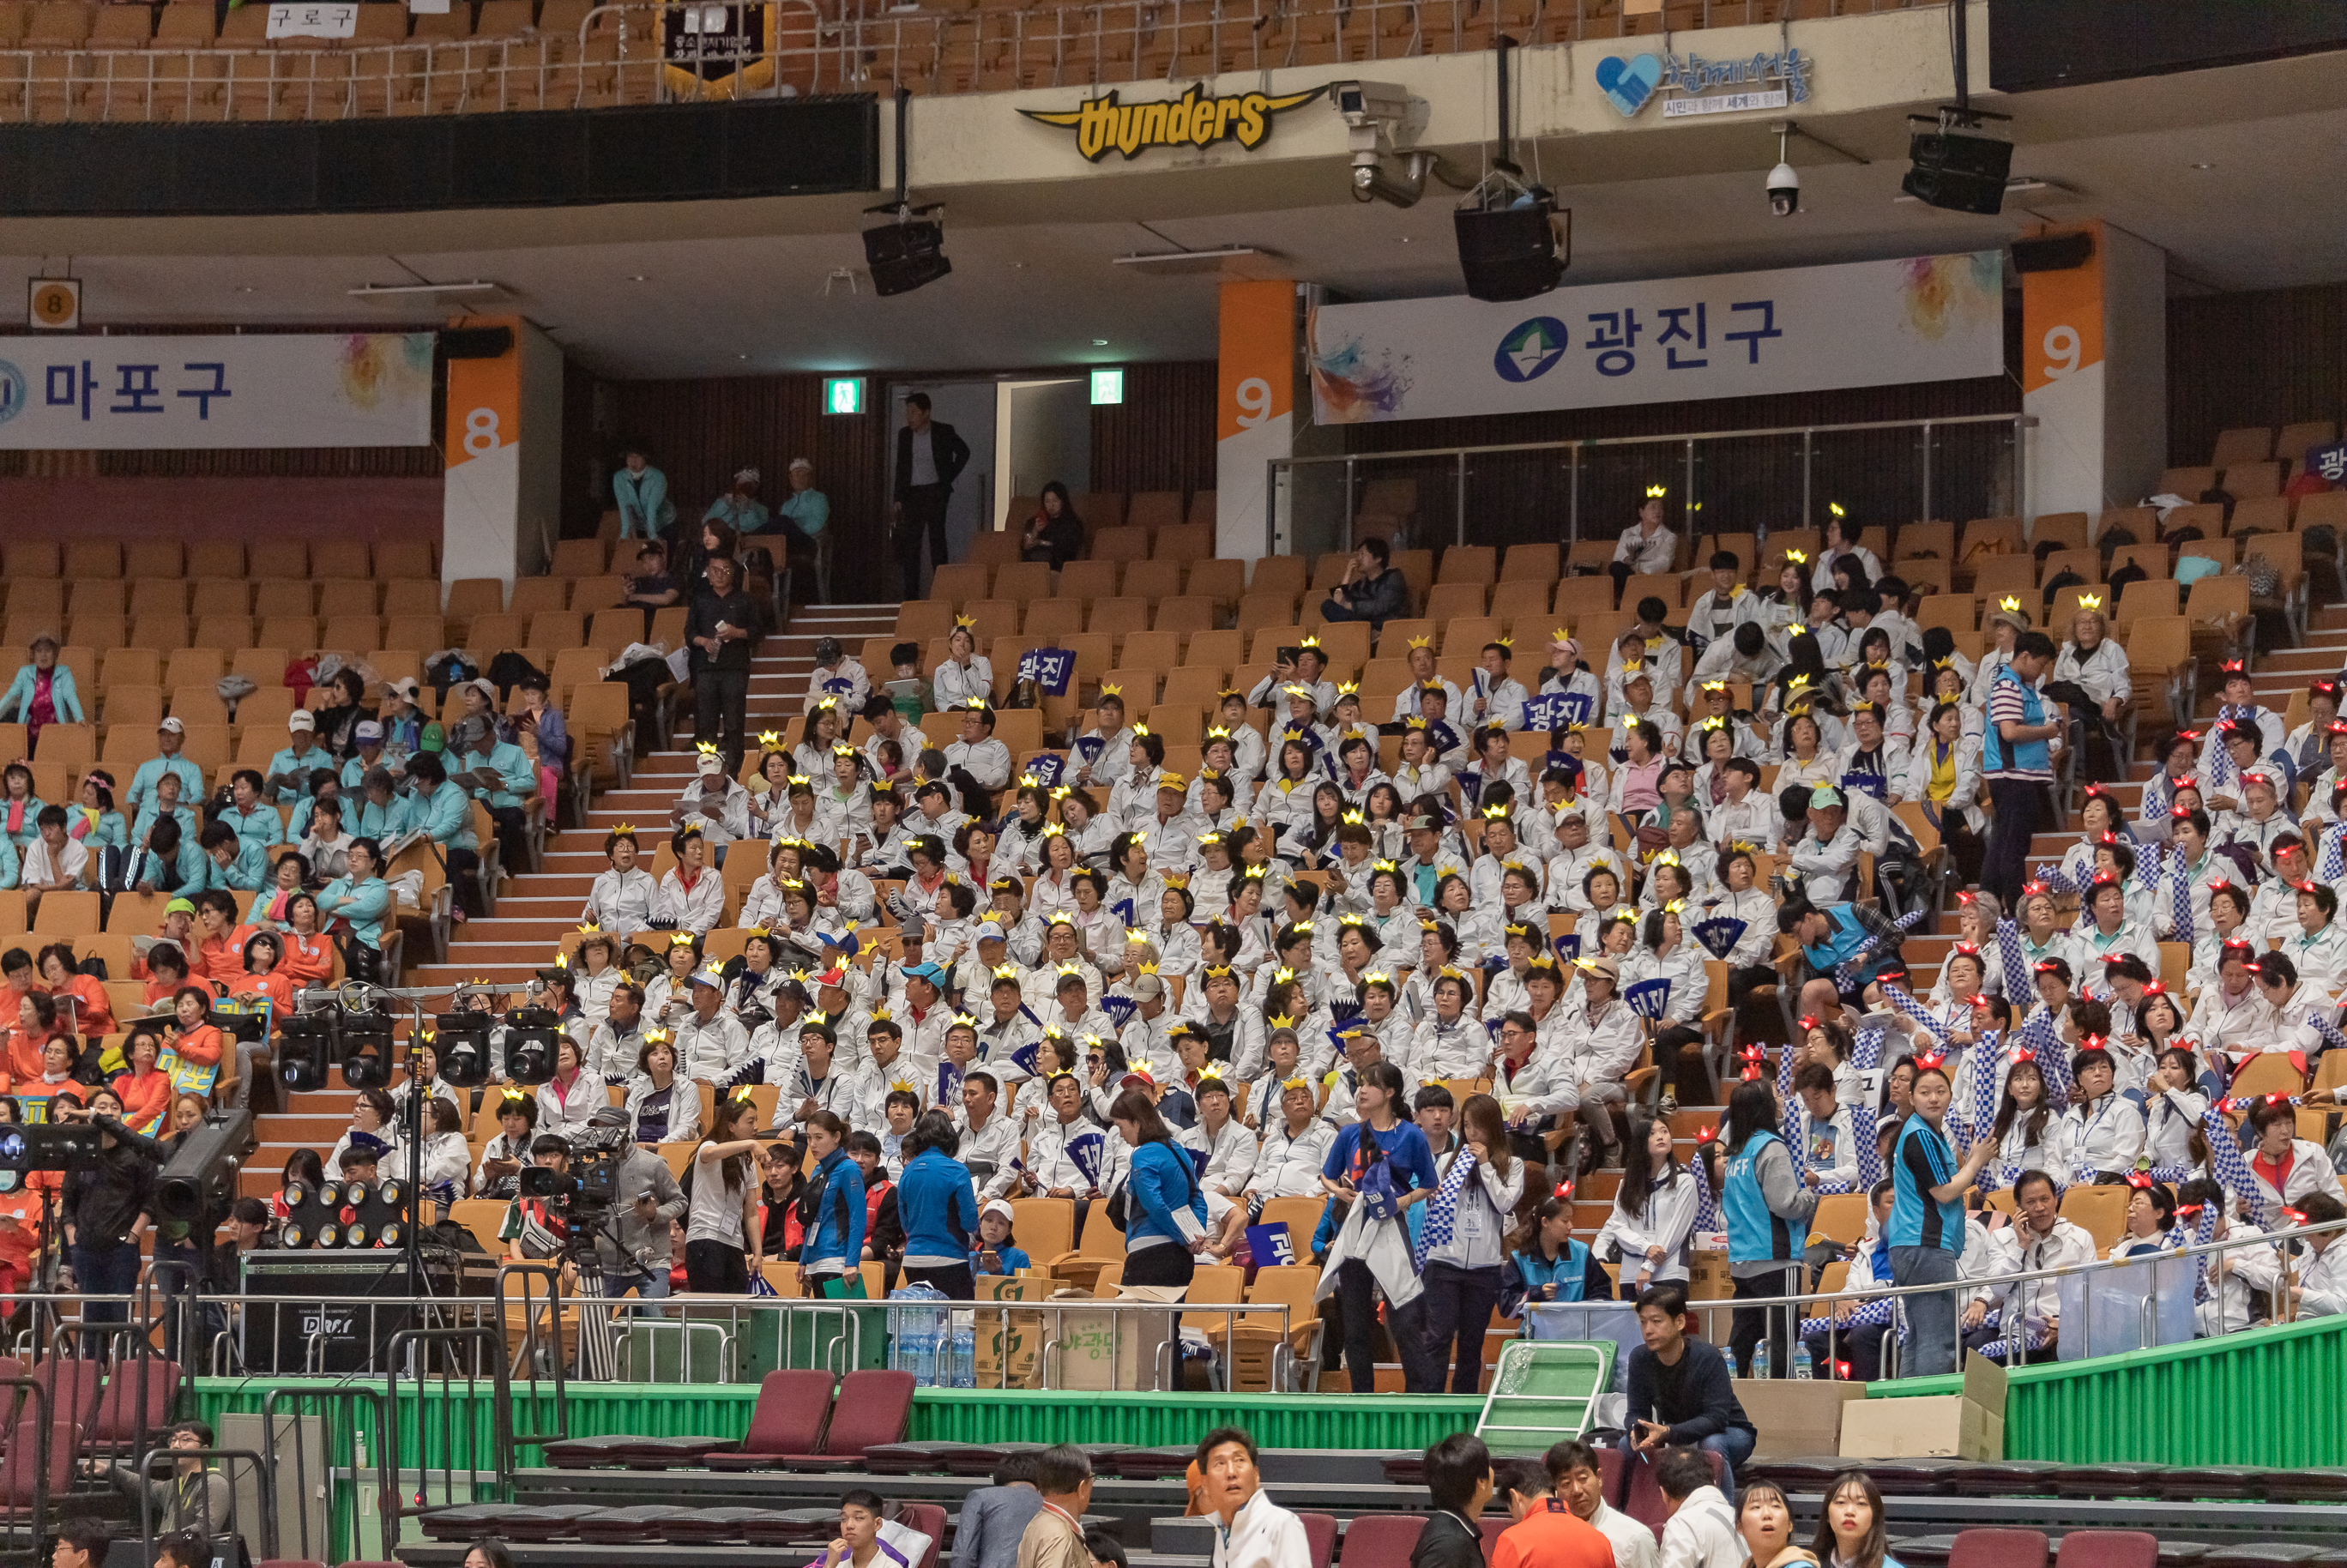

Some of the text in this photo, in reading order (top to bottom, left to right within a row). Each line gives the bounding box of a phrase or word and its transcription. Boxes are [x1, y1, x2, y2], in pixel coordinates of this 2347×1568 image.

[270, 9, 353, 28] 구로구
[1078, 86, 1270, 160] thunders
[46, 294, 62, 314] 8
[1585, 300, 1783, 377] 광진구
[2042, 325, 2081, 380] 9
[45, 359, 232, 421] 마포구
[1235, 377, 1272, 429] 9
[462, 407, 500, 458] 8
